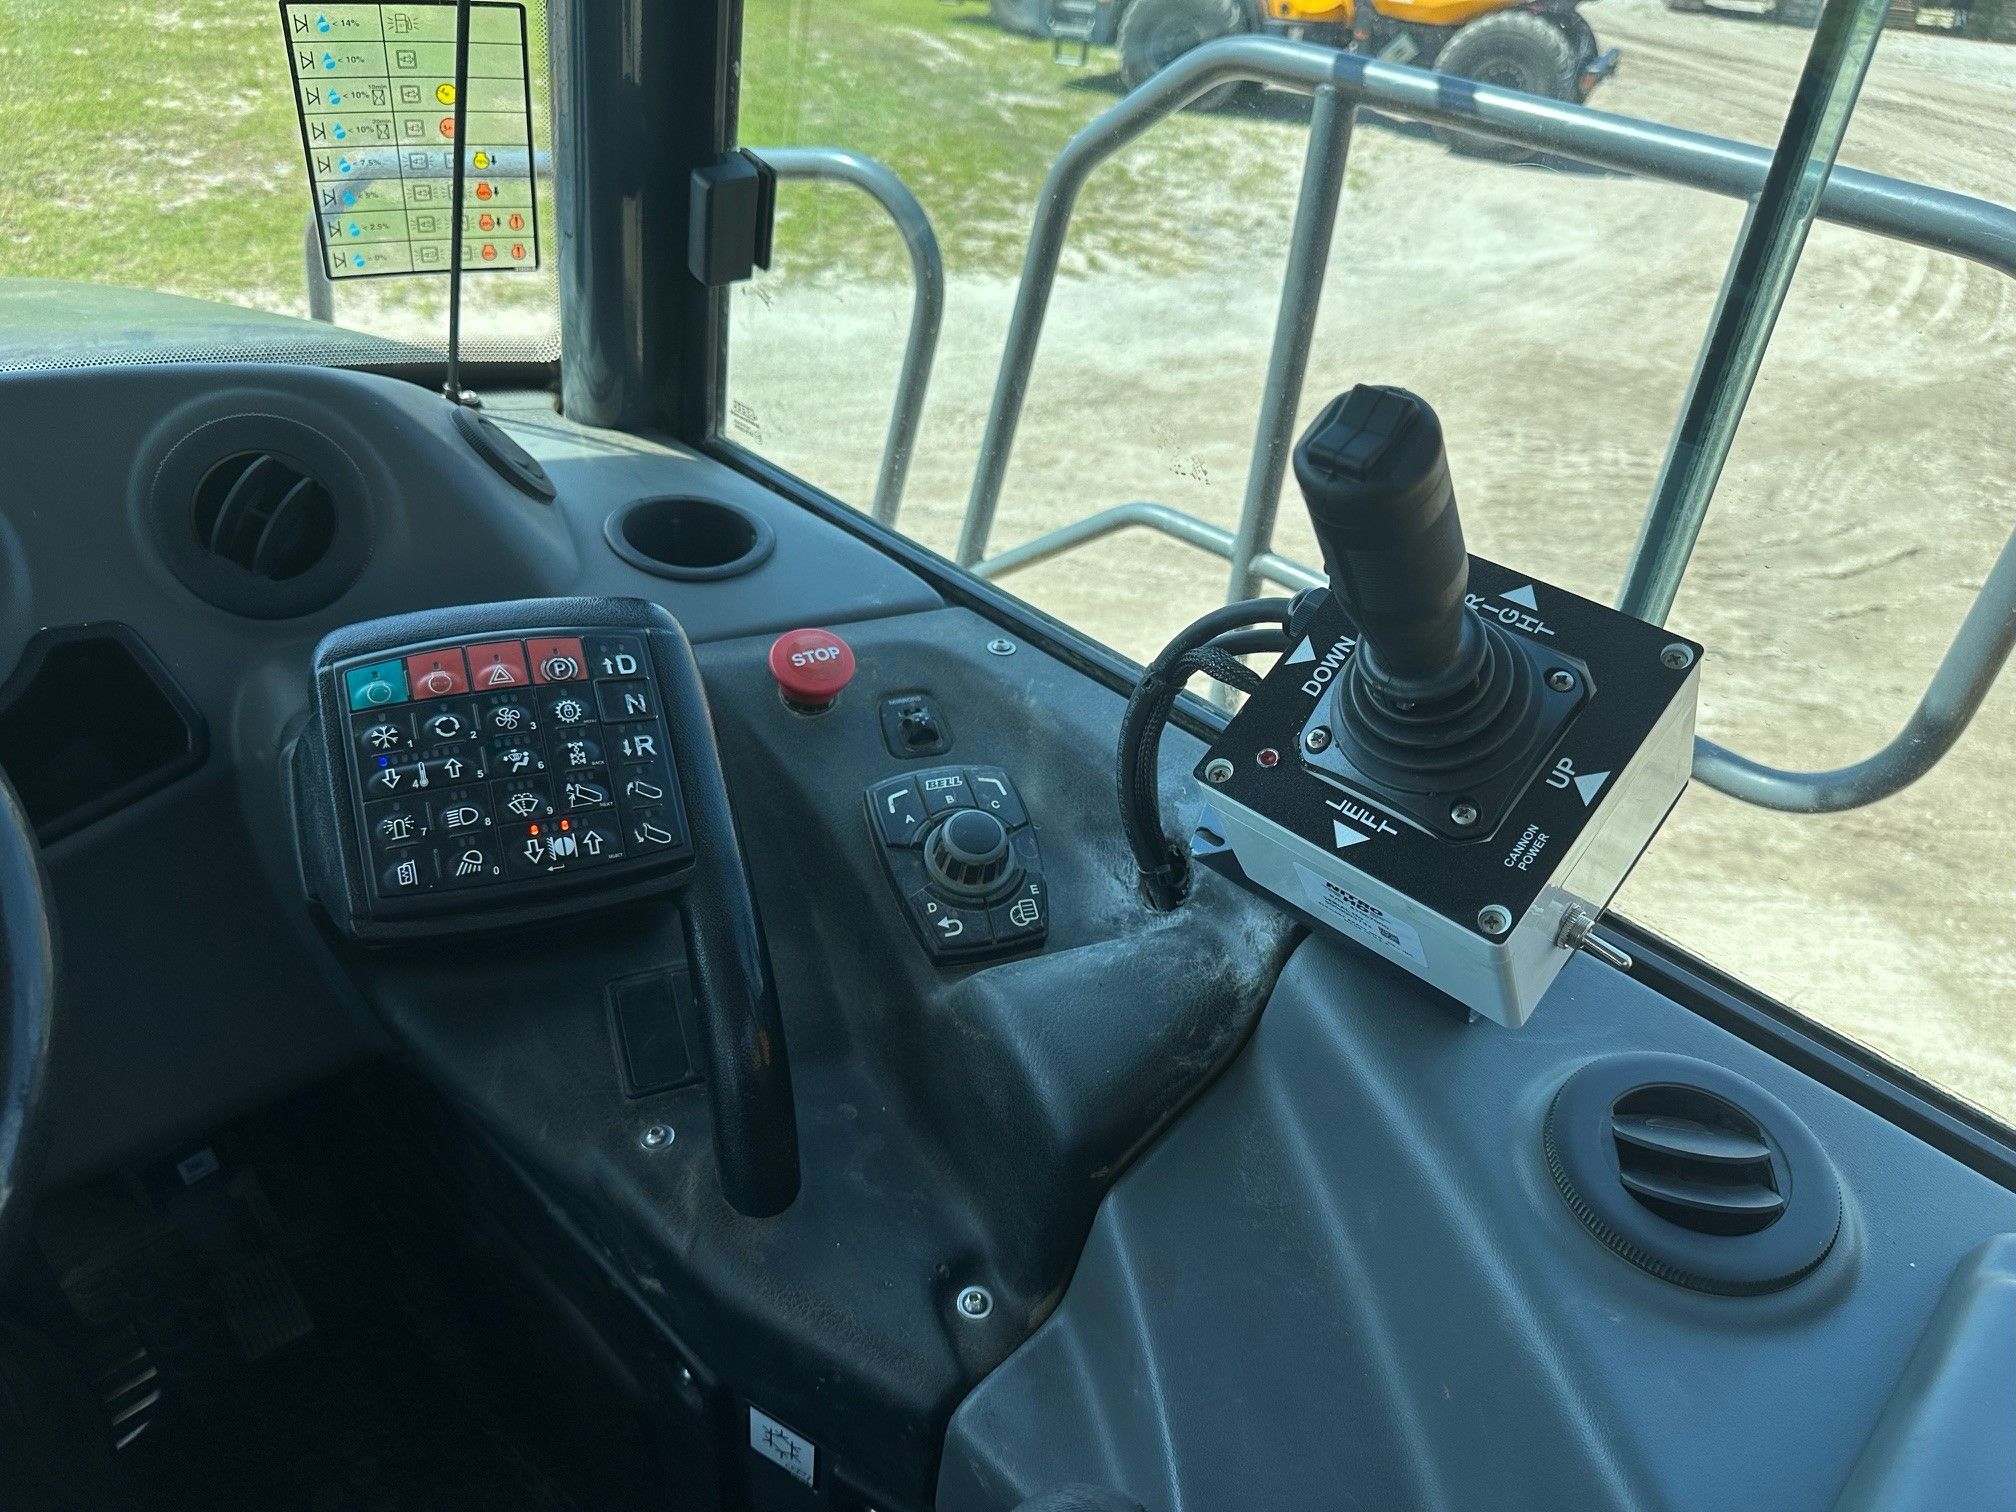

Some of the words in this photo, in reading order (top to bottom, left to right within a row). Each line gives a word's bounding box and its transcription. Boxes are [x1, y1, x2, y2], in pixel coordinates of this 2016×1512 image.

[341, 19, 360, 27] 14%
[346, 55, 365, 64] 10%
[351, 91, 370, 99] 10%
[356, 125, 375, 133] 10%
[361, 159, 382, 167] 7.5%
[370, 223, 390, 231] 2.5%
[1464, 593, 1556, 636] RIGHT
[791, 646, 840, 667] STOP
[615, 654, 637, 675] D
[1301, 635, 1357, 697] DOWN
[624, 693, 647, 715] N
[530, 721, 537, 730] 3
[470, 730, 478, 739] 2
[407, 739, 414, 748] 1
[633, 735, 658, 757] R
[537, 760, 545, 770] 6
[477, 769, 484, 778] 5
[1545, 757, 1576, 789] UP
[412, 779, 419, 788] 4
[925, 775, 963, 791] BELL
[945, 794, 955, 804] B
[990, 800, 1001, 809] C
[546, 806, 554, 815] 9
[484, 817, 492, 826] 8
[905, 814, 915, 824] A
[1325, 799, 1398, 835] LEFT
[420, 827, 428, 836] 7
[1504, 823, 1540, 868] CANNON
[1517, 832, 1551, 872] POWER
[493, 865, 500, 875] 0
[1029, 884, 1040, 895] E
[1326, 881, 1384, 917] NITRO
[927, 902, 938, 913] D
